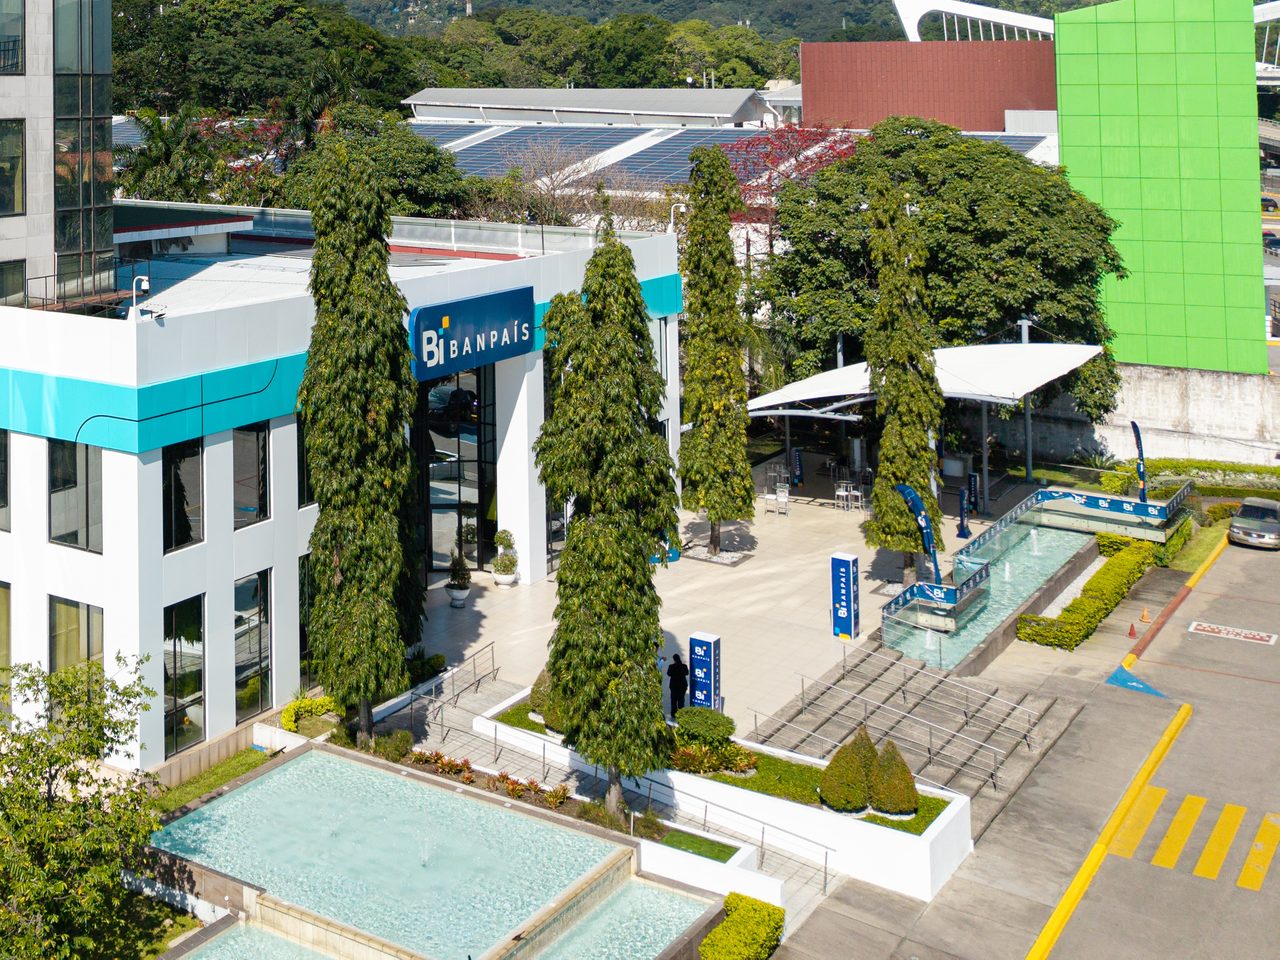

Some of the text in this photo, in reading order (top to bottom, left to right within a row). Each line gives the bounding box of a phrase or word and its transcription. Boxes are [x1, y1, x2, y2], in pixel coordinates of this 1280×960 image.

[422, 320, 530, 368] Bi BANPAÍS
[694, 646, 705, 656] Bi
[695, 668, 705, 678] Bi
[695, 690, 705, 701] Bi
